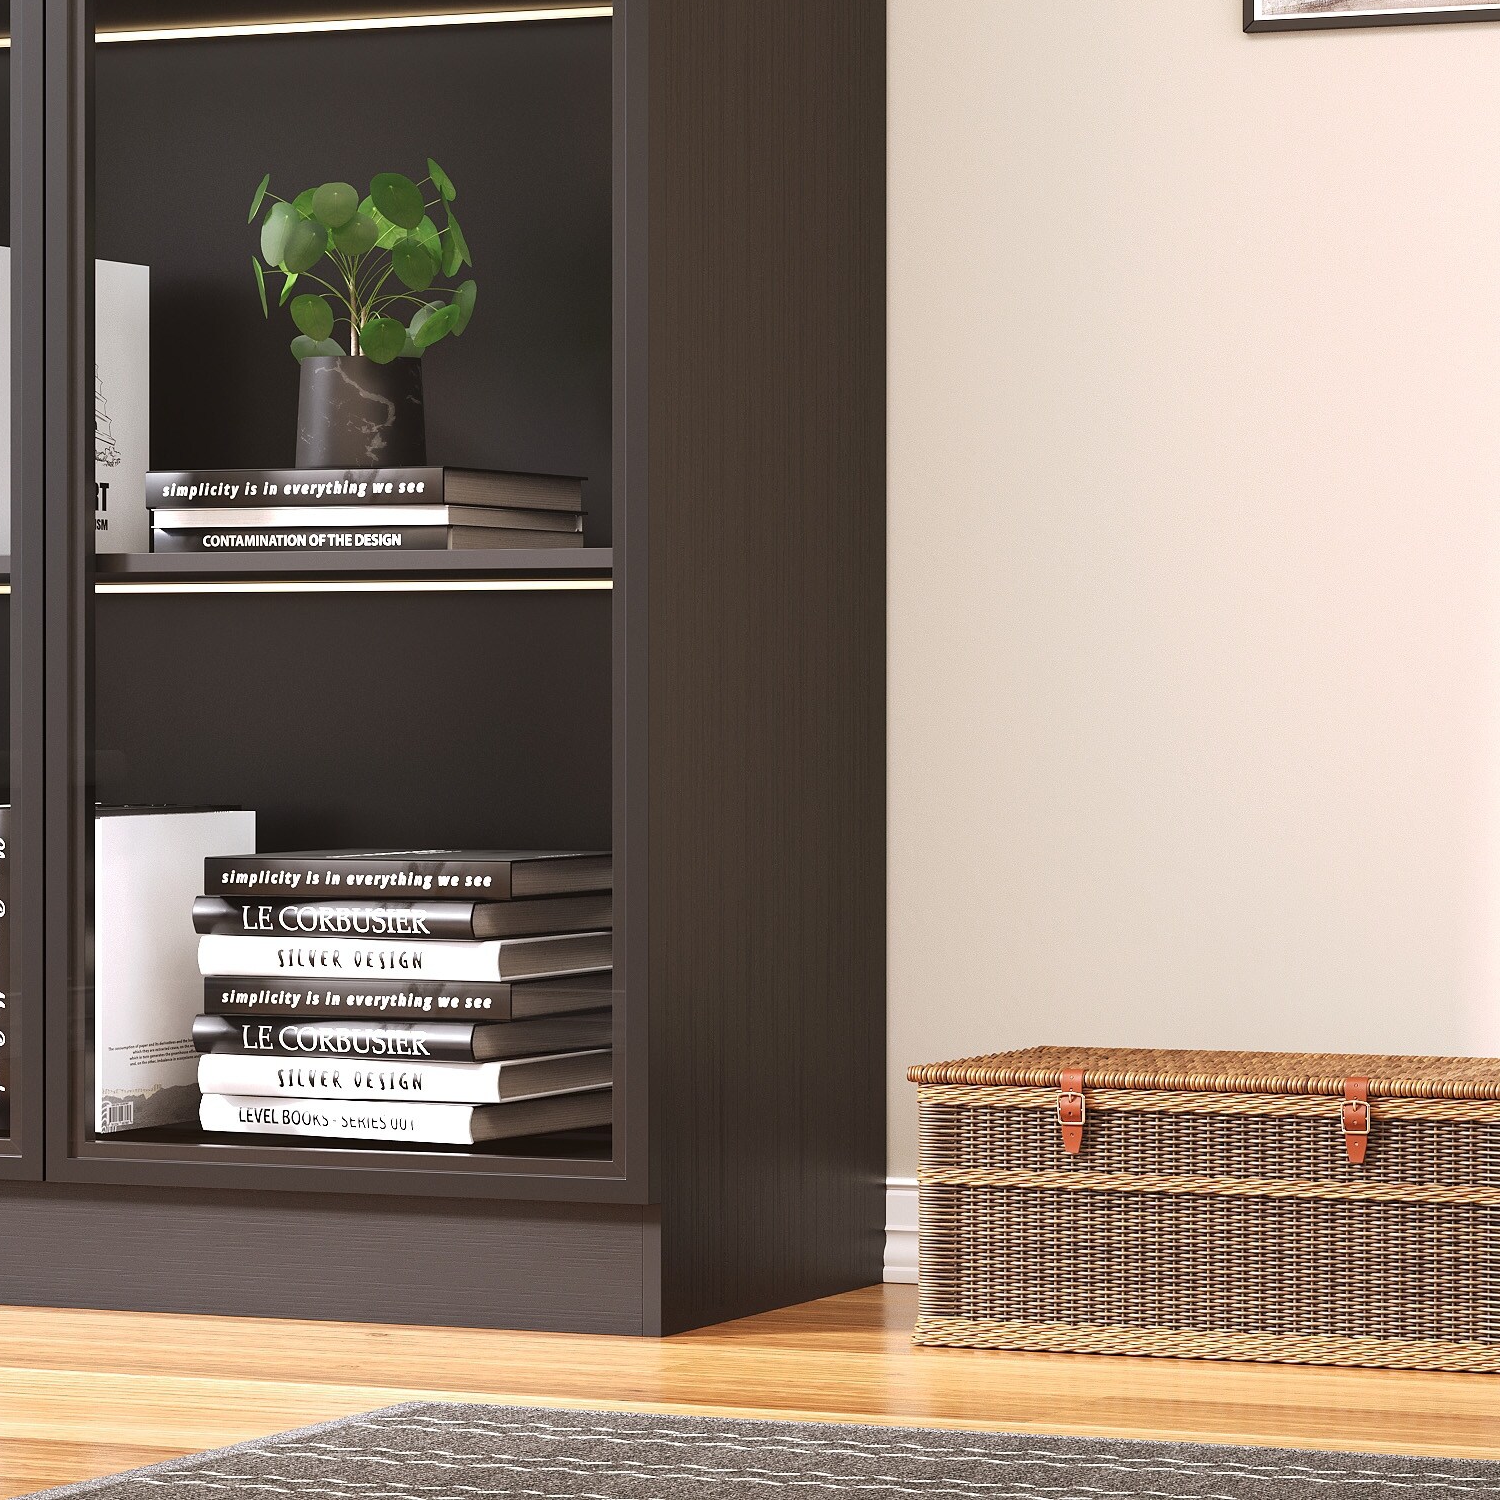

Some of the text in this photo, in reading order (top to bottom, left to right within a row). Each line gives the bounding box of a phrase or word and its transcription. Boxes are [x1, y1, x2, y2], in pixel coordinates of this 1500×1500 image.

[162, 480, 425, 500] simplicity is in everything we see
[202, 533, 402, 548] CONTAMINATION OF THE DESIGN
[221, 869, 492, 890] simplicity is in everything we see
[241, 905, 430, 935] LE CORBUSIER
[277, 948, 423, 970] SILVER DESIGN
[221, 989, 492, 1011] simplicity is in everything we see
[241, 1024, 430, 1056] LE CORBUSIER
[277, 1068, 423, 1091] SILVER DESIGN
[239, 1106, 278, 1125] LEVEL
[282, 1109, 329, 1127] BOOKS
[341, 1114, 387, 1130] SERIES
